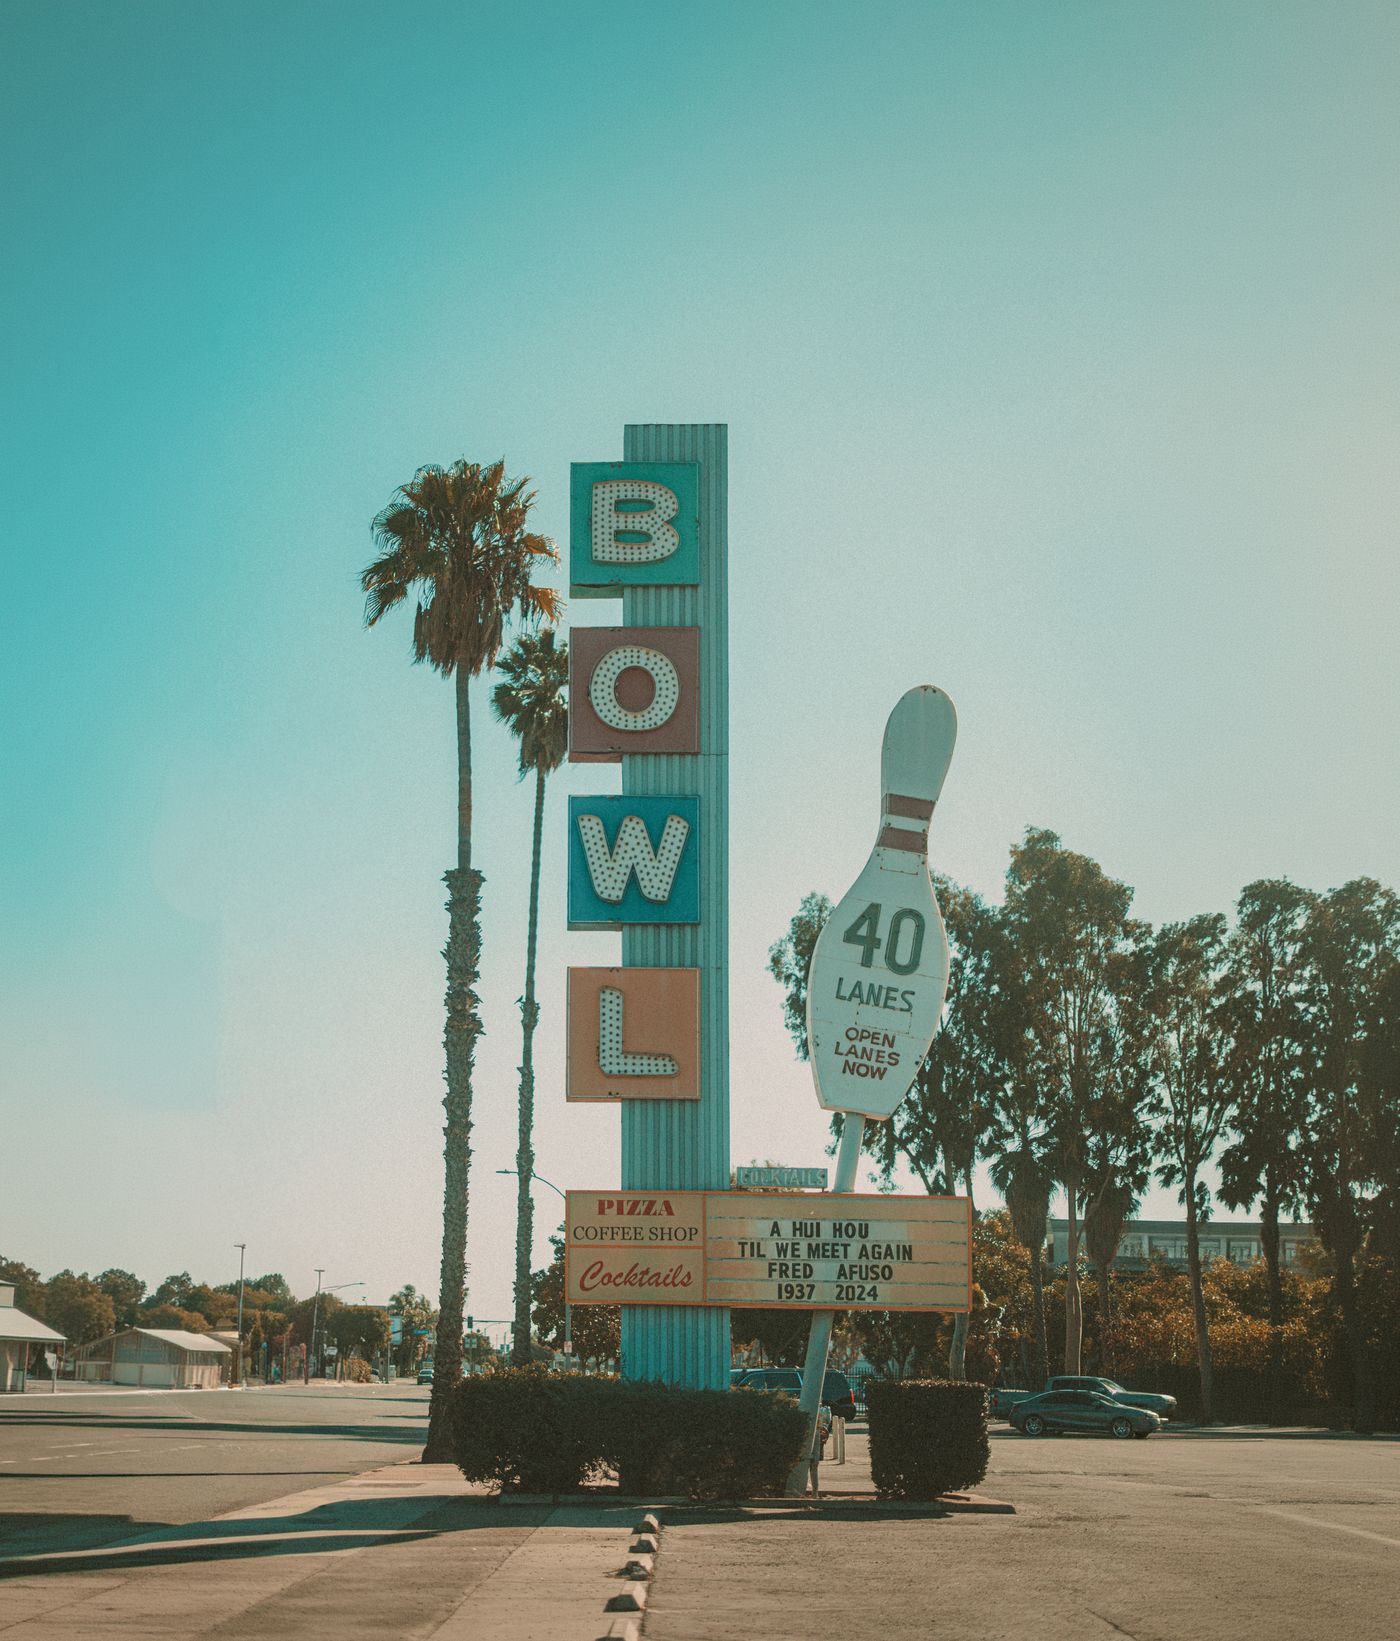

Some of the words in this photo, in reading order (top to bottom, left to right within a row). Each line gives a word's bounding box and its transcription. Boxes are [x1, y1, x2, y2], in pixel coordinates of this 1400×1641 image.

[577, 479, 691, 1077] BOWL
[843, 903, 925, 976] 40
[835, 977, 915, 1012] LANES
[845, 1026, 896, 1048] OPEN
[834, 1041, 900, 1067] LANES
[842, 1059, 888, 1081] NOW
[598, 1200, 675, 1216] PIZZA
[573, 1225, 645, 1241] COFFEE
[649, 1227, 698, 1241] SHOP
[770, 1222, 781, 1237] A
[792, 1222, 821, 1238] HUI
[832, 1223, 869, 1239] HOU
[738, 1242, 766, 1258] TIL
[776, 1242, 800, 1259] WE
[807, 1243, 850, 1260] MEET
[858, 1244, 912, 1260] AGAIN
[579, 1261, 694, 1292] Cocktails
[768, 1262, 813, 1279] FRED
[836, 1264, 893, 1280] AFUSO
[778, 1284, 815, 1300] 1937
[835, 1284, 879, 1301] 2024
